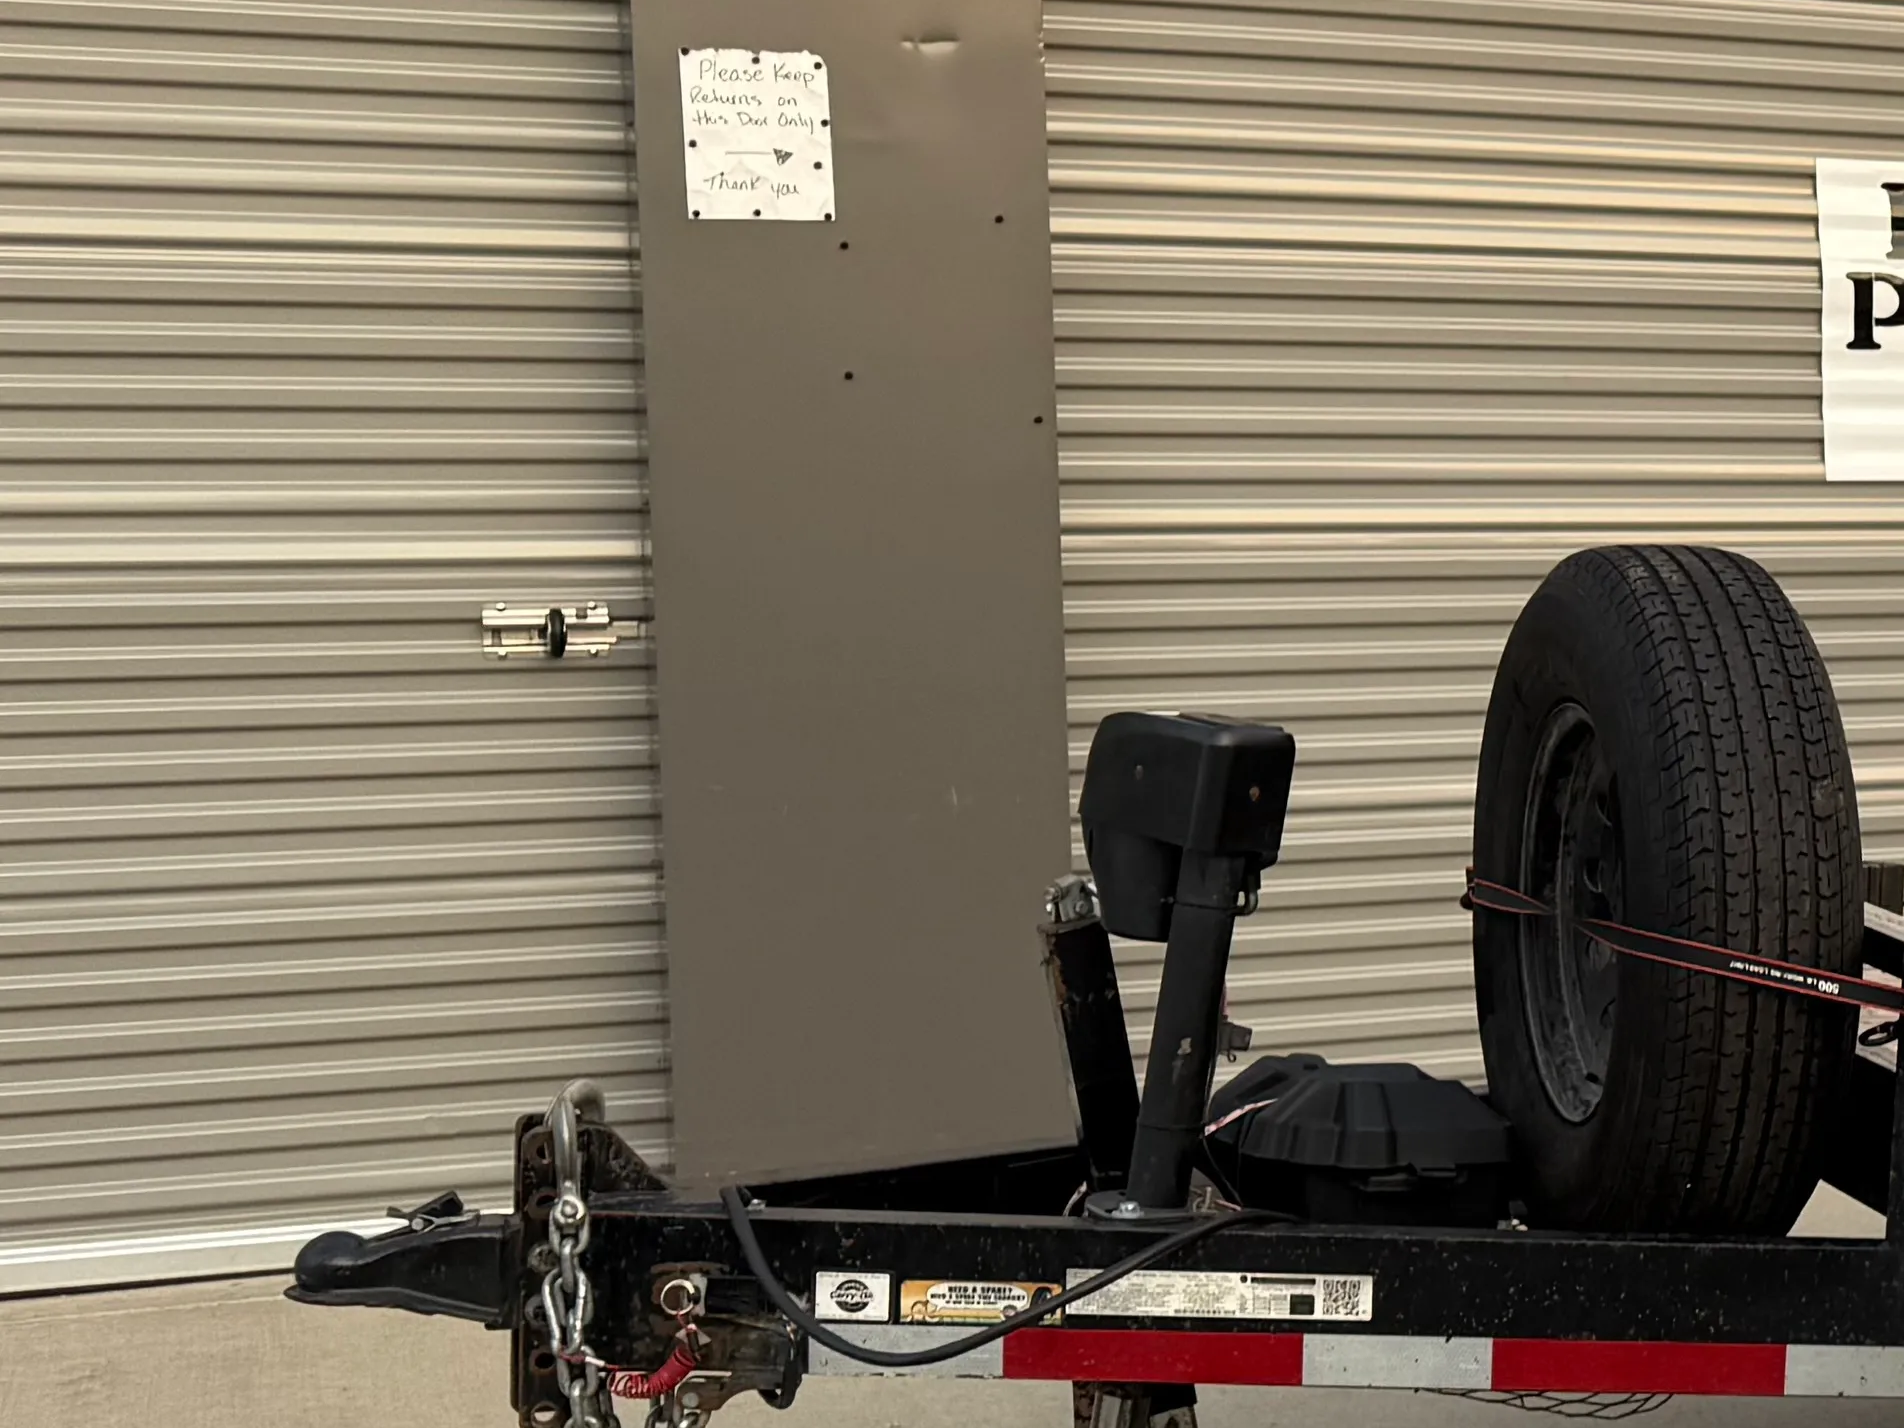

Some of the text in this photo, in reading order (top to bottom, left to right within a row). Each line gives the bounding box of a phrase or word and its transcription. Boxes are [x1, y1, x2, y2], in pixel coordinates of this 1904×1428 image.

[700, 58, 814, 88] Please Keep
[690, 85, 798, 107] Returns on
[778, 112, 814, 135] Only
[703, 175, 760, 191] Thank
[1818, 980, 1840, 995] 500
